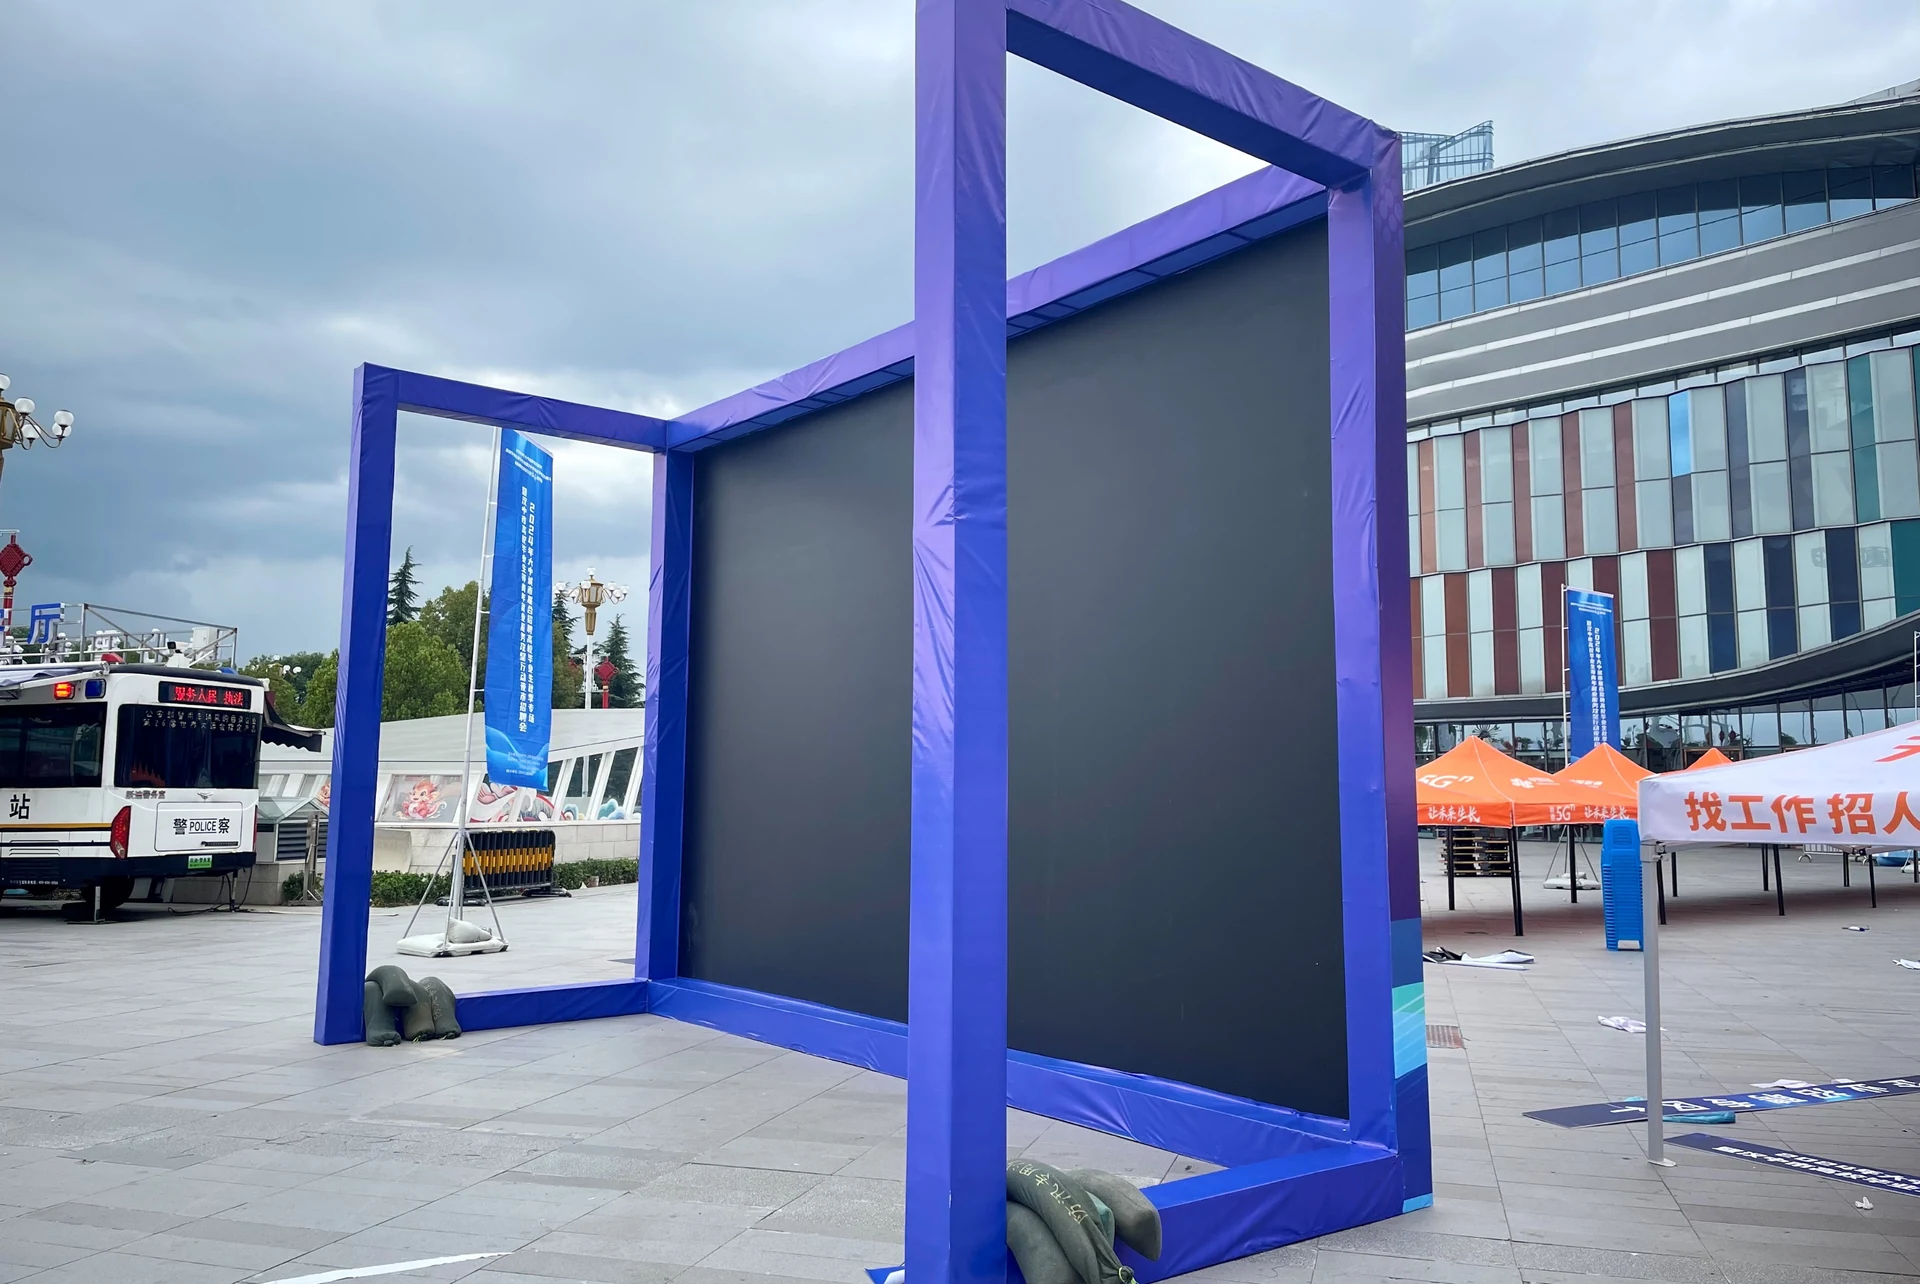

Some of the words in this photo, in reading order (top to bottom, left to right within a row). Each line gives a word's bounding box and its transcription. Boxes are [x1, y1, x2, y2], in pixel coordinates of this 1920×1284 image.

[173, 686, 217, 704] 服务人民
[223, 690, 243, 706] 执法
[9, 794, 30, 820] 站
[1428, 804, 1480, 823] 让未来生长
[1584, 805, 1630, 820] 让未来生长
[1684, 791, 1817, 835] 找工作
[173, 818, 187, 835] 警
[189, 821, 217, 832] POLICE
[218, 817, 230, 834] 察
